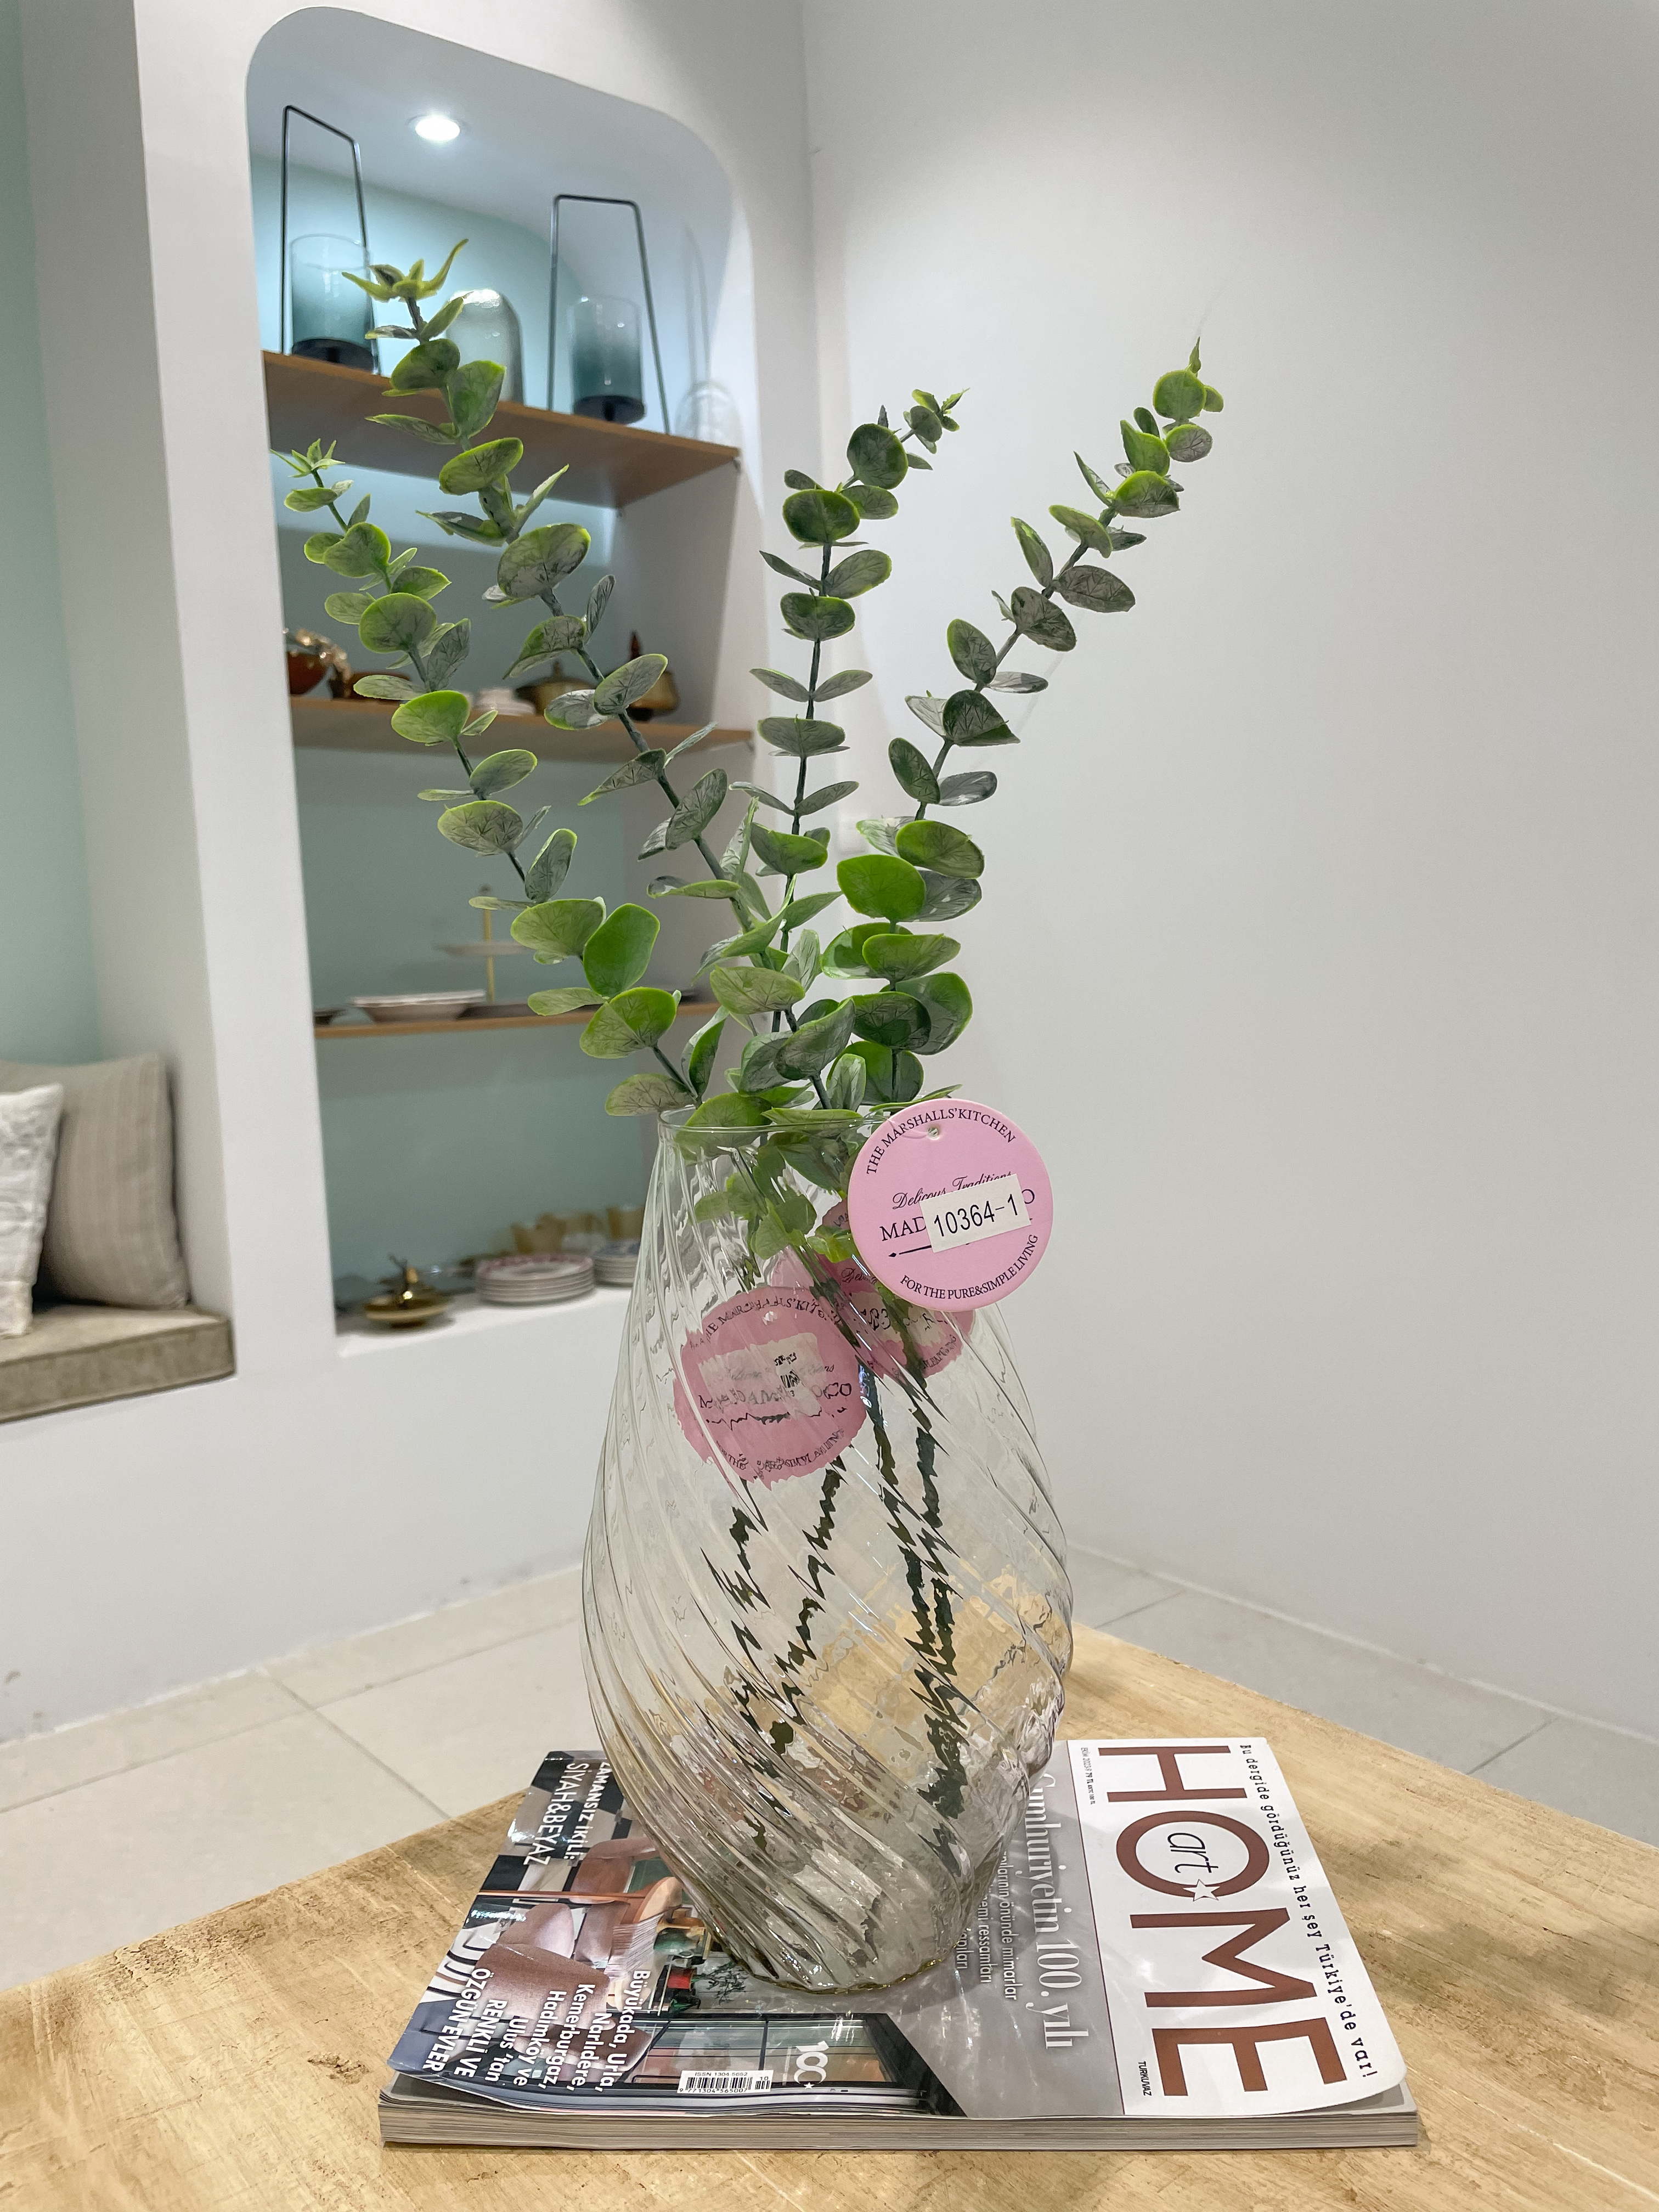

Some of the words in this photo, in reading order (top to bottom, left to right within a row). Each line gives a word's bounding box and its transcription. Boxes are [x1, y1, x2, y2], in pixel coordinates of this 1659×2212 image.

[866, 1146, 885, 1175] THE
[934, 1194, 1018, 1237] 10364-1
[900, 1274, 922, 1294] FOR
[923, 1285, 945, 1299] THE
[1013, 1234, 1038, 1271] LIVING
[1240, 1745, 1251, 1754] Bu
[1246, 1758, 1269, 1799] dergide
[523, 1763, 593, 1865] SİYAH&BEYAZ
[563, 1825, 594, 1860] İKİLİ:
[1167, 1832, 1220, 1873] art
[1261, 1805, 1301, 1880] gördüğünüz
[1293, 1885, 1311, 1908] her
[999, 1901, 1019, 1944] önünde
[1098, 1746, 1348, 2096] HOME
[1301, 1914, 1322, 1937] şey
[956, 1930, 975, 1969] apıları
[978, 1924, 998, 1983] ressamları
[1036, 1939, 1082, 1997] 100.
[448, 1968, 494, 2023] ÖZGÜN
[1002, 1948, 1024, 2000] mimarlar
[1316, 1943, 1357, 2030] Türkiye'de
[465, 1999, 508, 2053] RENKLİ
[518, 1990, 567, 2064] Hadımköy
[608, 1970, 652, 2049] Büyükada,
[1025, 2002, 1089, 2050] yılı
[422, 2025, 464, 2072] EVLER
[499, 2018, 529, 2049] Ulus
[538, 1984, 596, 2090] Kemerburgaz,
[566, 2012, 613, 2091] Narlıdere,
[453, 2057, 482, 2078] VE
[513, 2068, 533, 2086] ve
[595, 2053, 628, 2092] Urla,
[1137, 2061, 1152, 2097] TURKUVAZ
[1351, 2037, 1378, 2078] var!
